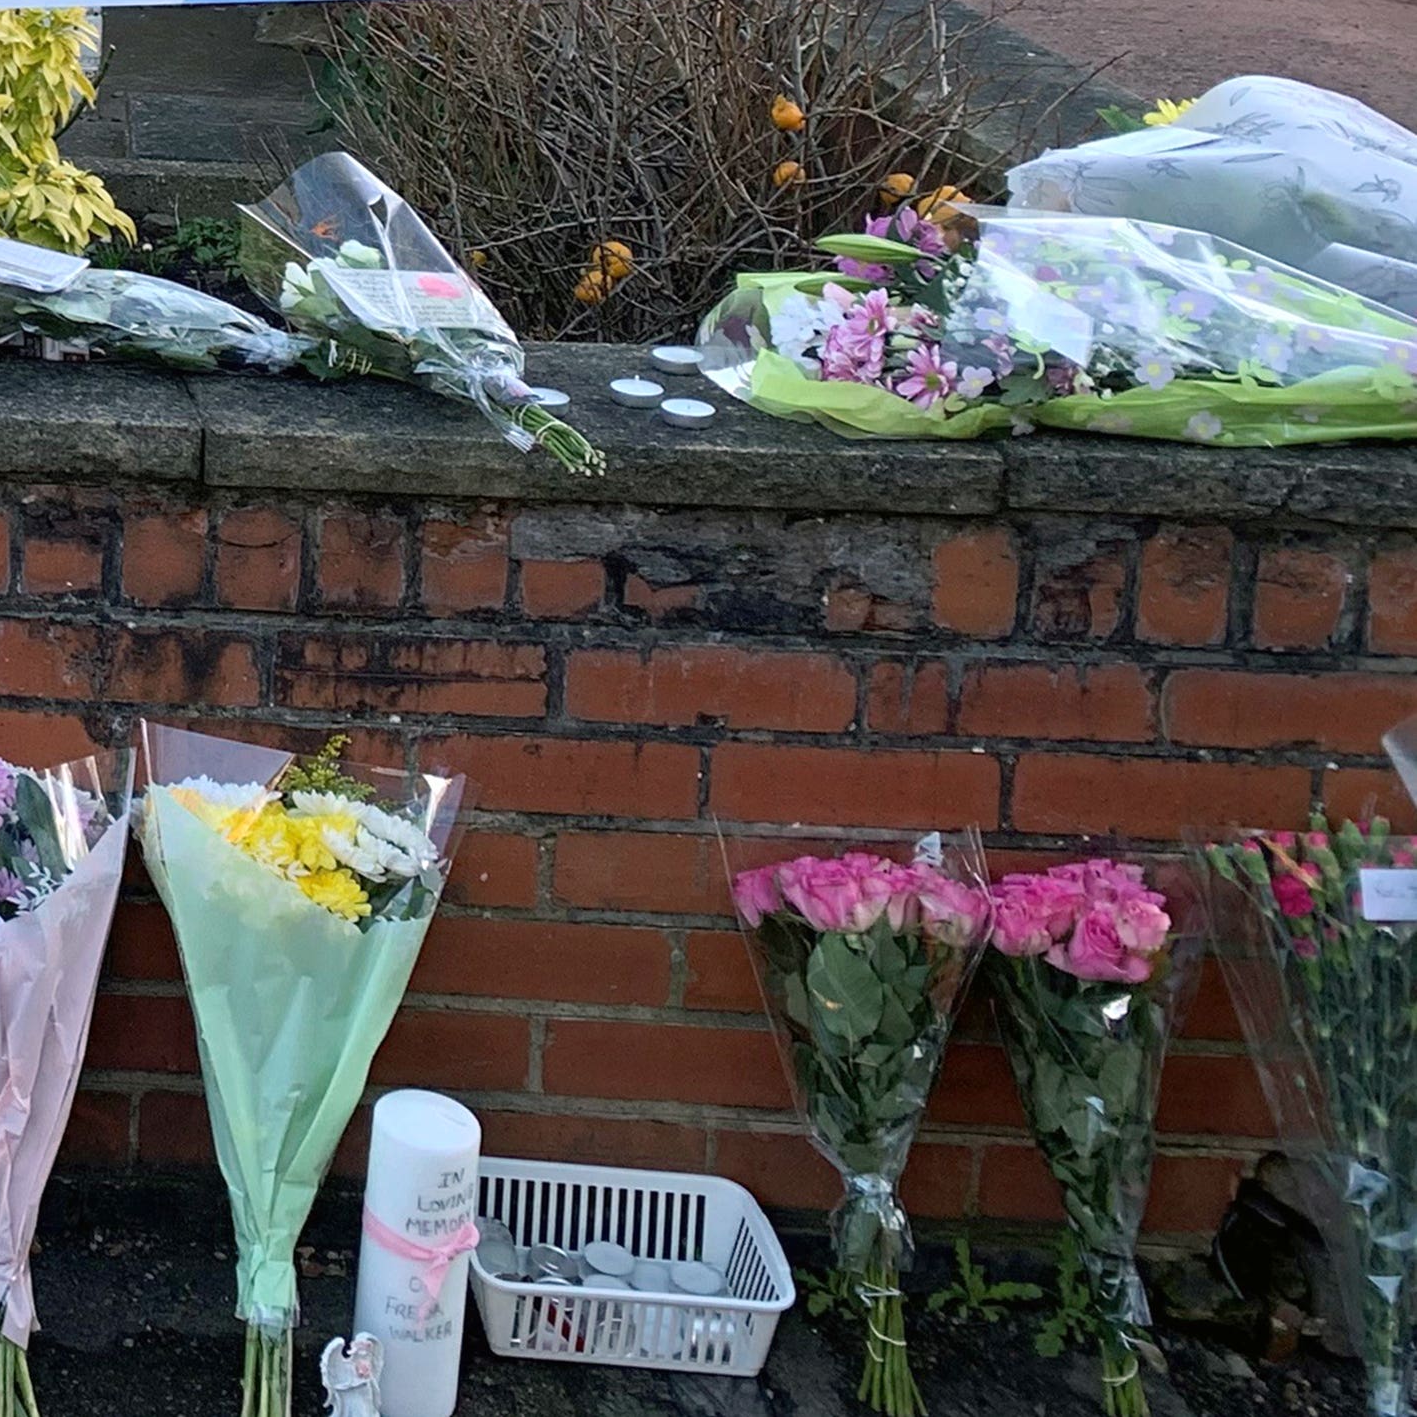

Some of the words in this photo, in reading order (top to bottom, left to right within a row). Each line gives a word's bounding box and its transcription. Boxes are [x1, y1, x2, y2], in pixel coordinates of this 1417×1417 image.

[438, 1168, 464, 1188] IN
[409, 1276, 423, 1293] O
[385, 1296, 444, 1321] FREA
[389, 1320, 453, 1343] WALKER
